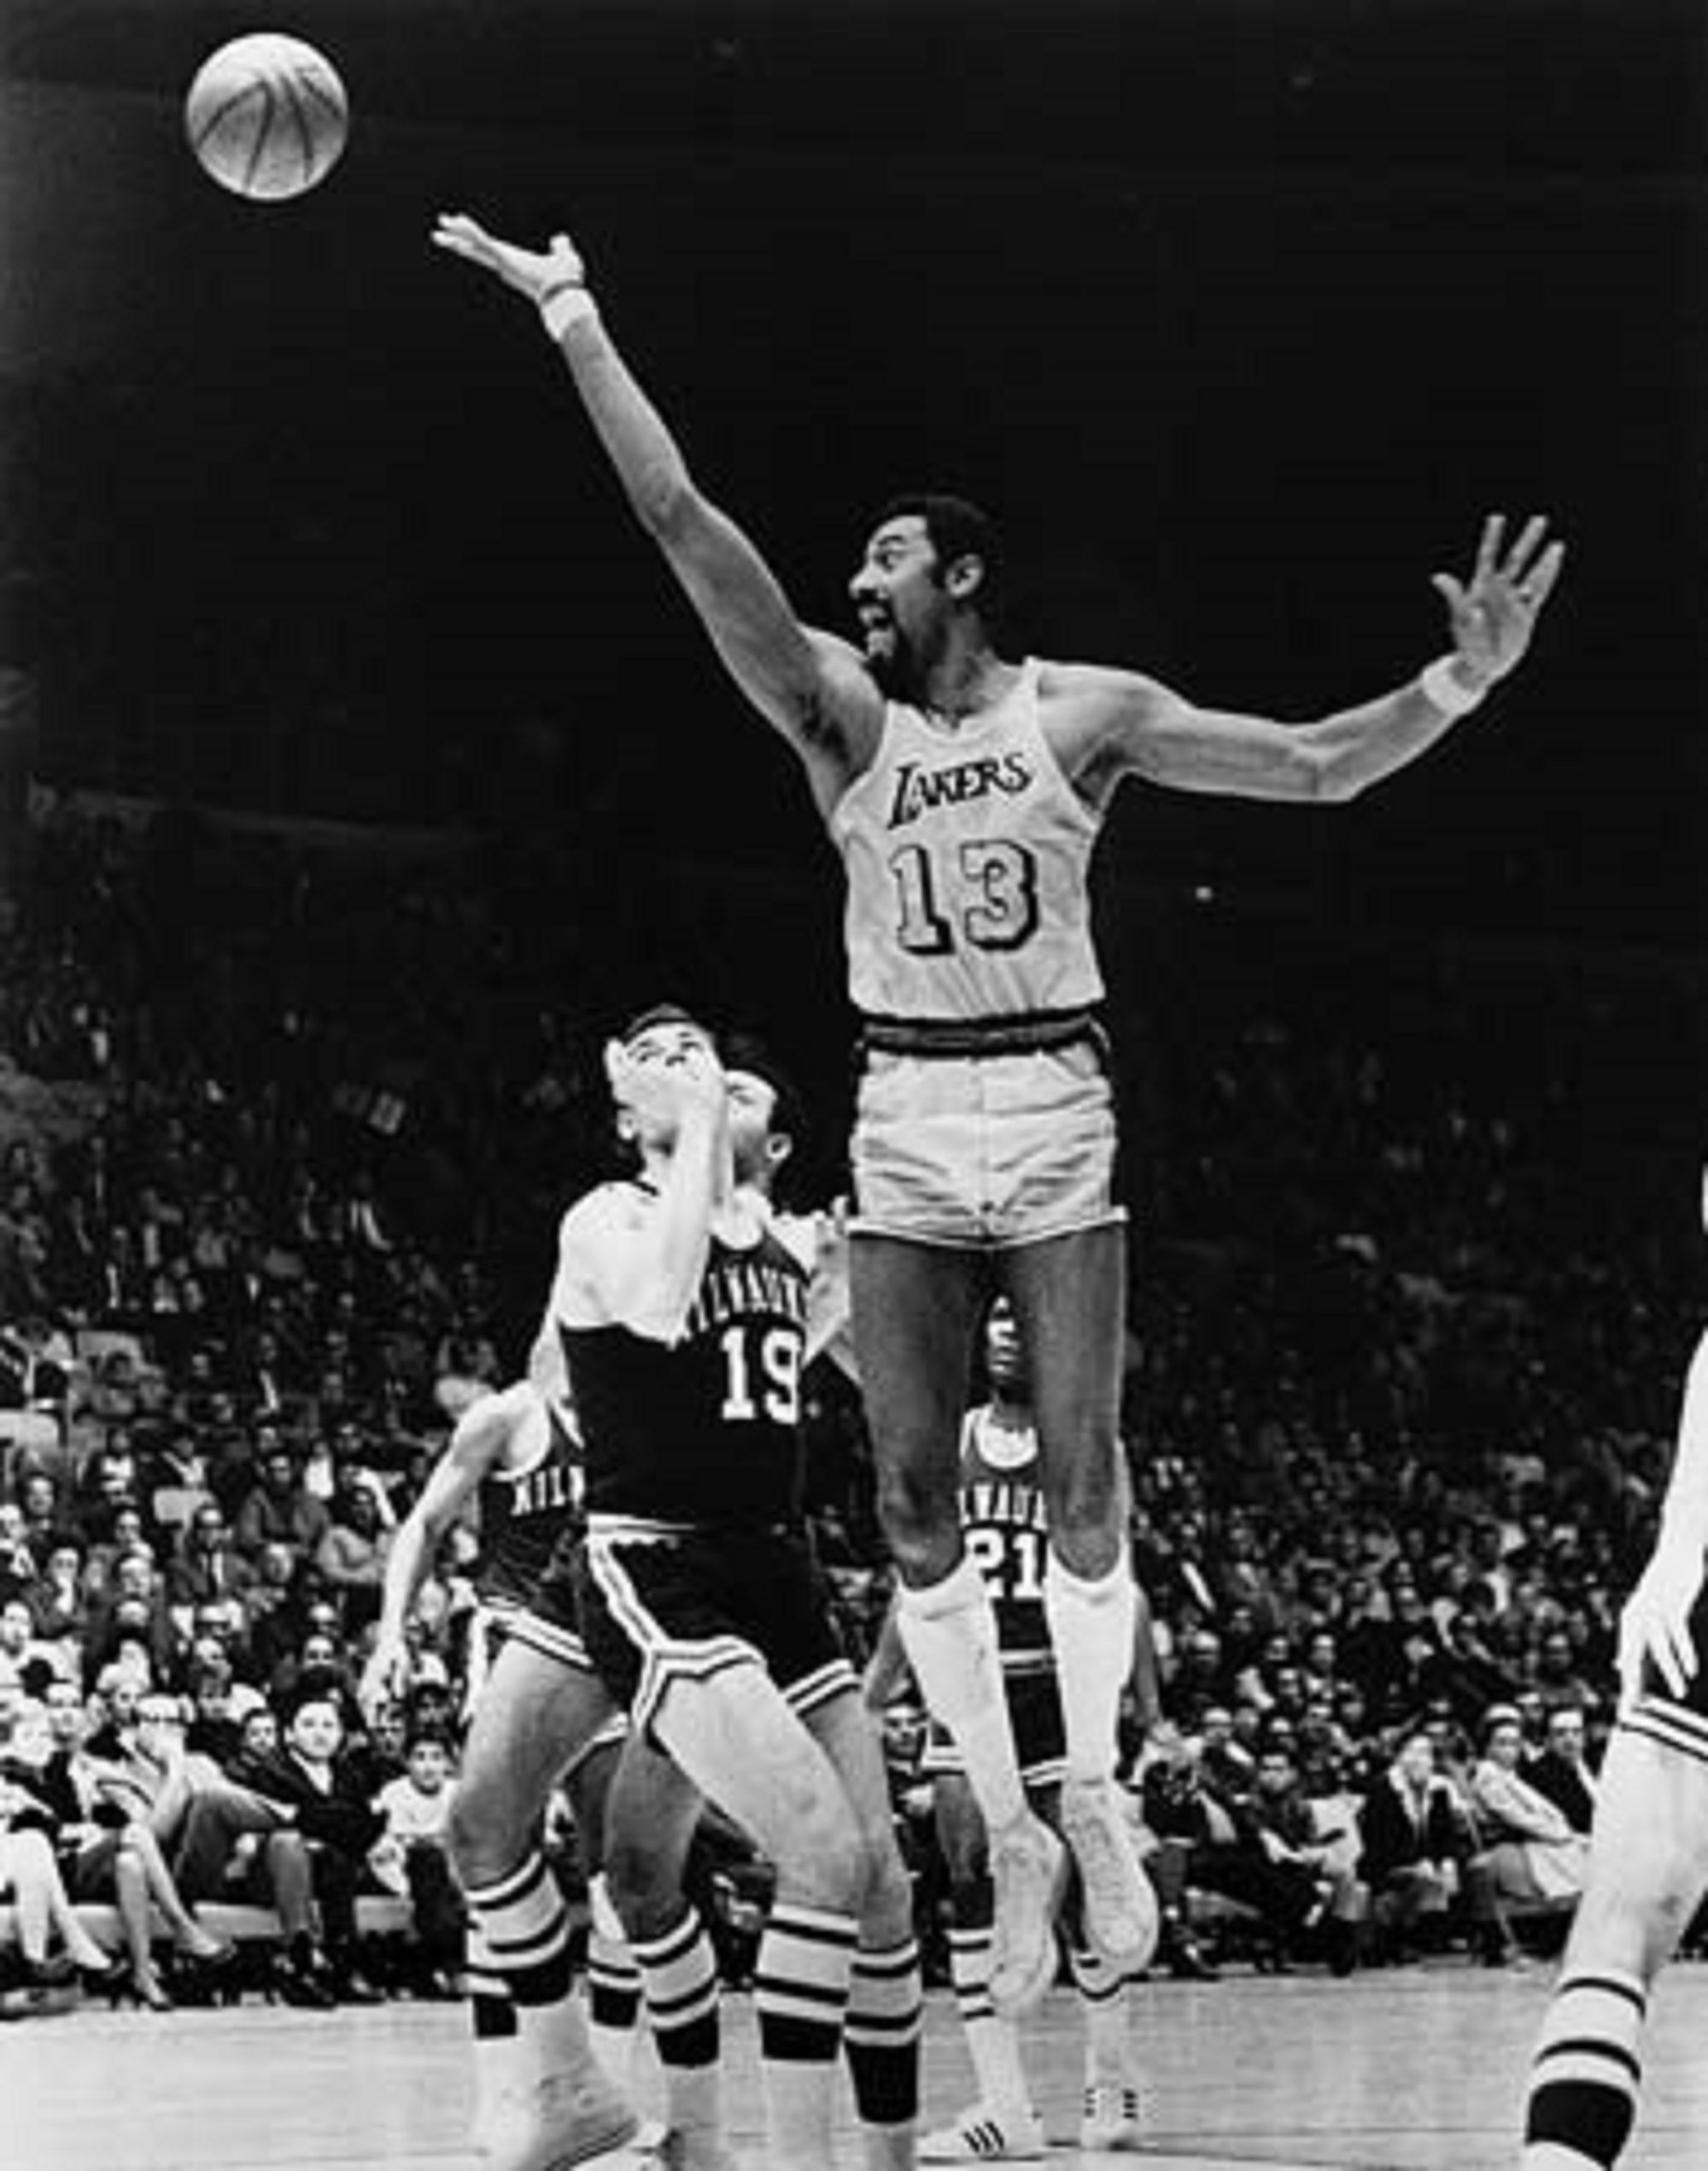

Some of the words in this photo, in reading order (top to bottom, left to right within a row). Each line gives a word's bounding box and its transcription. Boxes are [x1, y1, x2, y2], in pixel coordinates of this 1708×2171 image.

[887, 752, 1032, 830] LAKERS
[887, 840, 1039, 956] 13
[721, 1326, 802, 1425] 19
[964, 1527, 1043, 1599] 21
